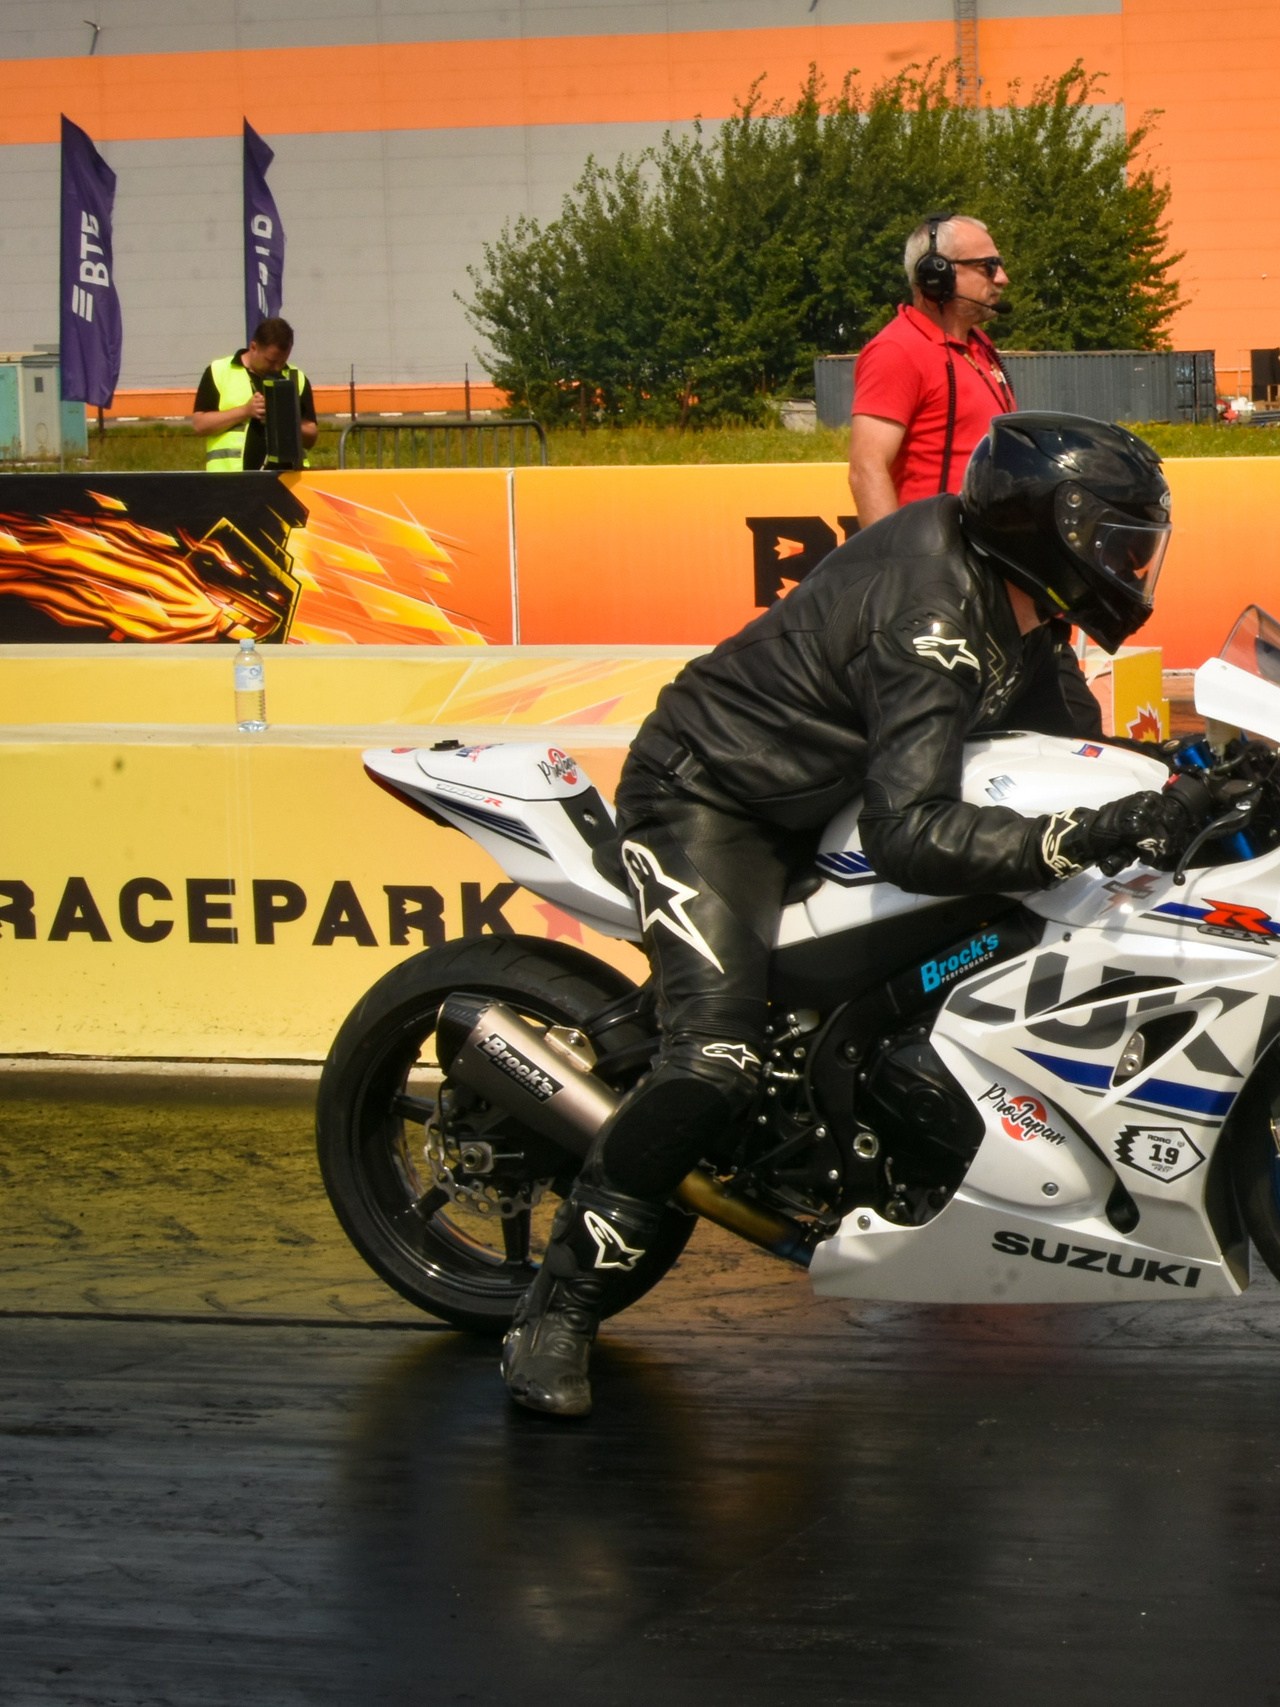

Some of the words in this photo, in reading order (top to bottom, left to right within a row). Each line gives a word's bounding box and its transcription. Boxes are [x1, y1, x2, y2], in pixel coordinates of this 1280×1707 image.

[0, 877, 520, 947] RACEPARK
[921, 933, 999, 993] Brock's
[941, 951, 994, 984] PERFORMANCE
[977, 1082, 1067, 1146] ProJapan
[1149, 1143, 1180, 1165] 19
[991, 1230, 1202, 1289] SUZUKI
